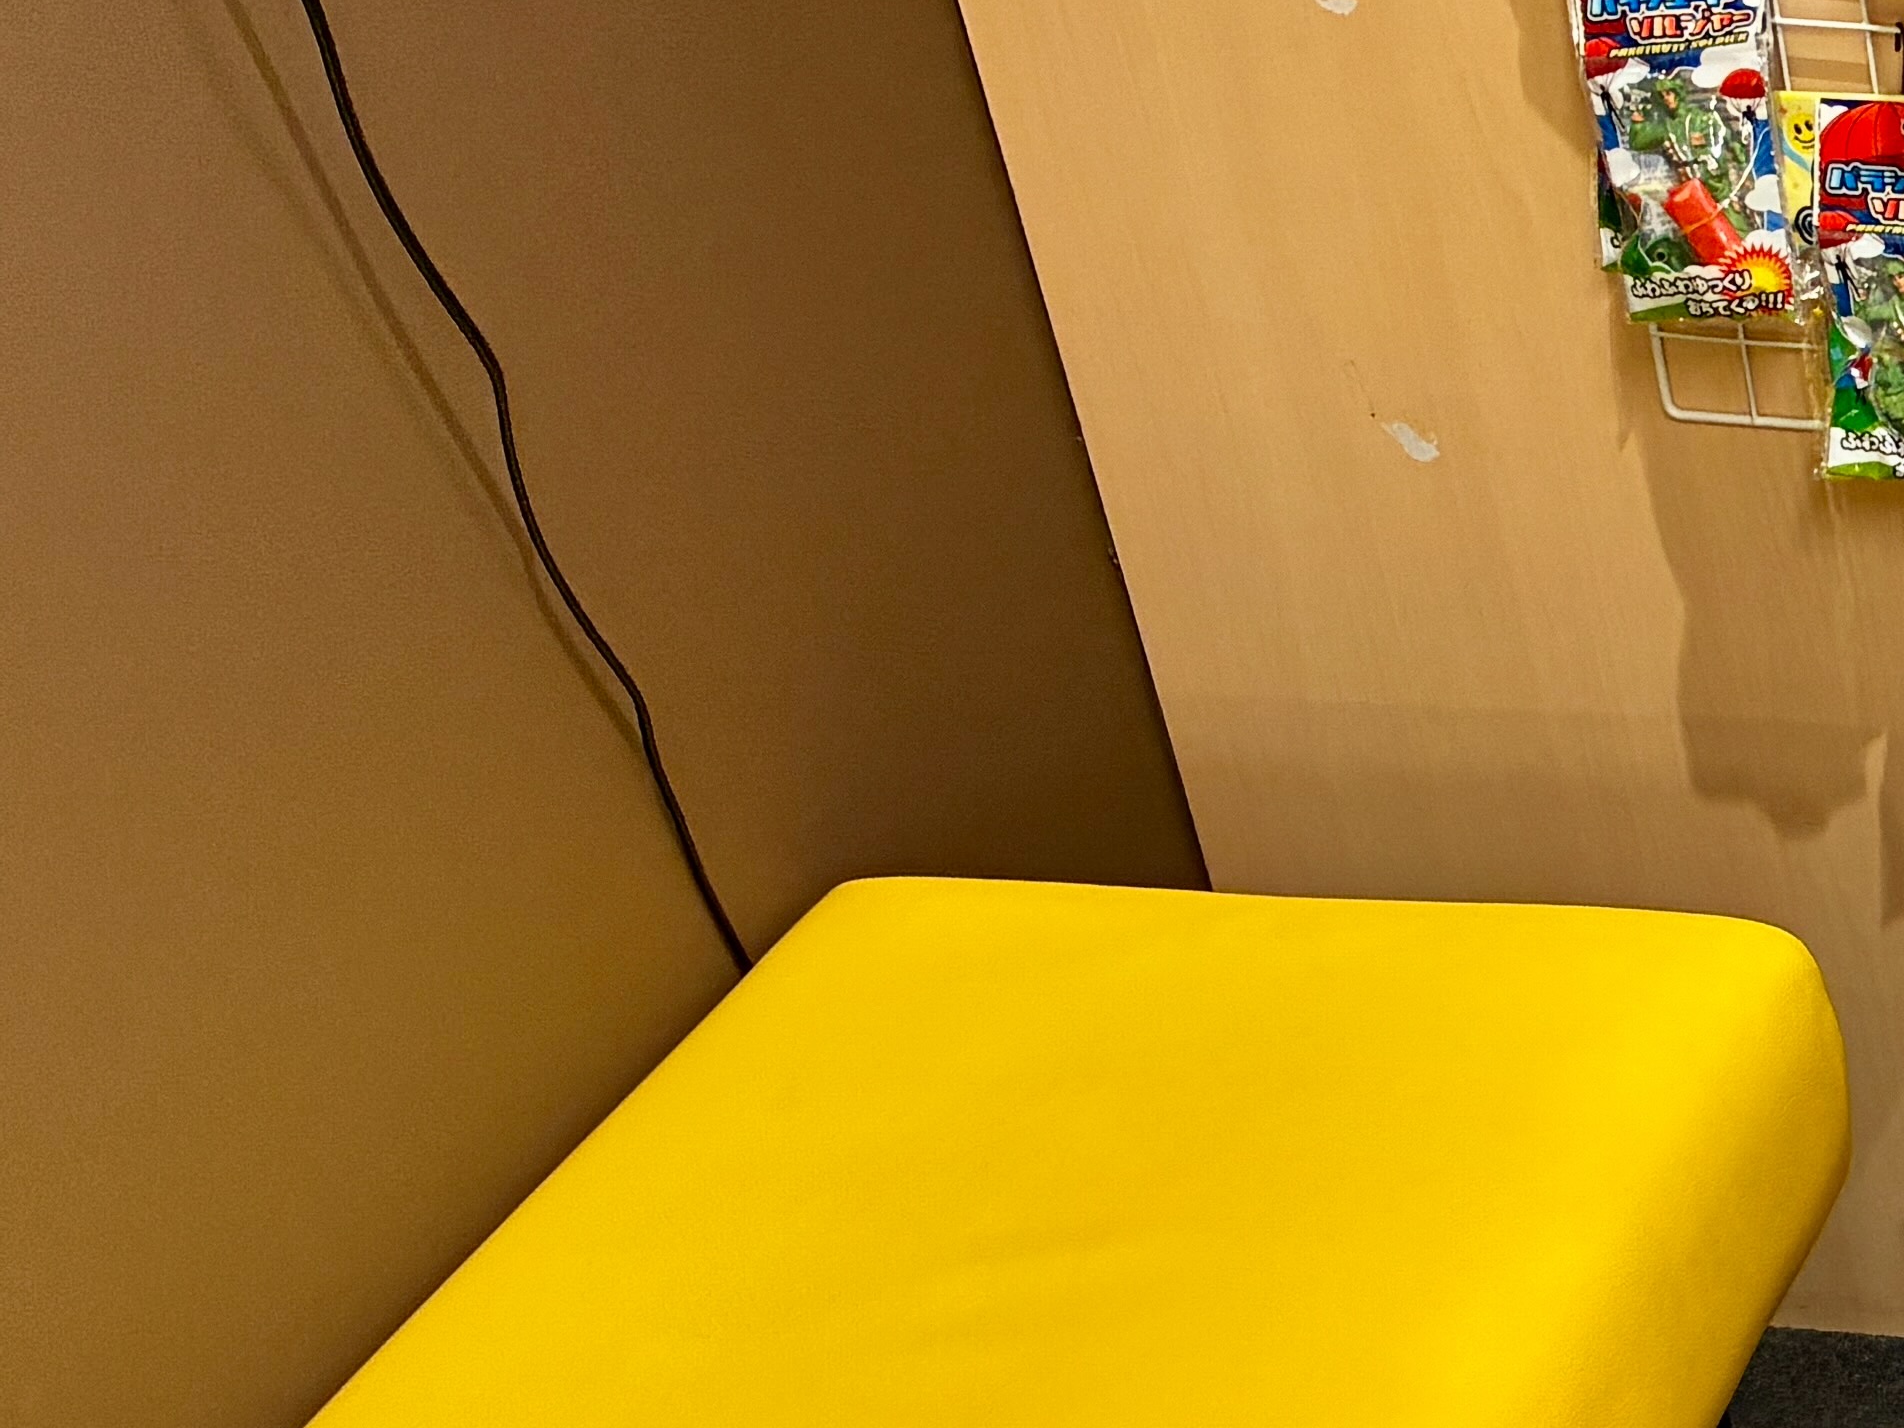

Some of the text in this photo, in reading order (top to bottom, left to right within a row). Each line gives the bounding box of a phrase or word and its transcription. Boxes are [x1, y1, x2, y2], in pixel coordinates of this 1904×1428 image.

[1628, 11, 1753, 41] ソルジャー
